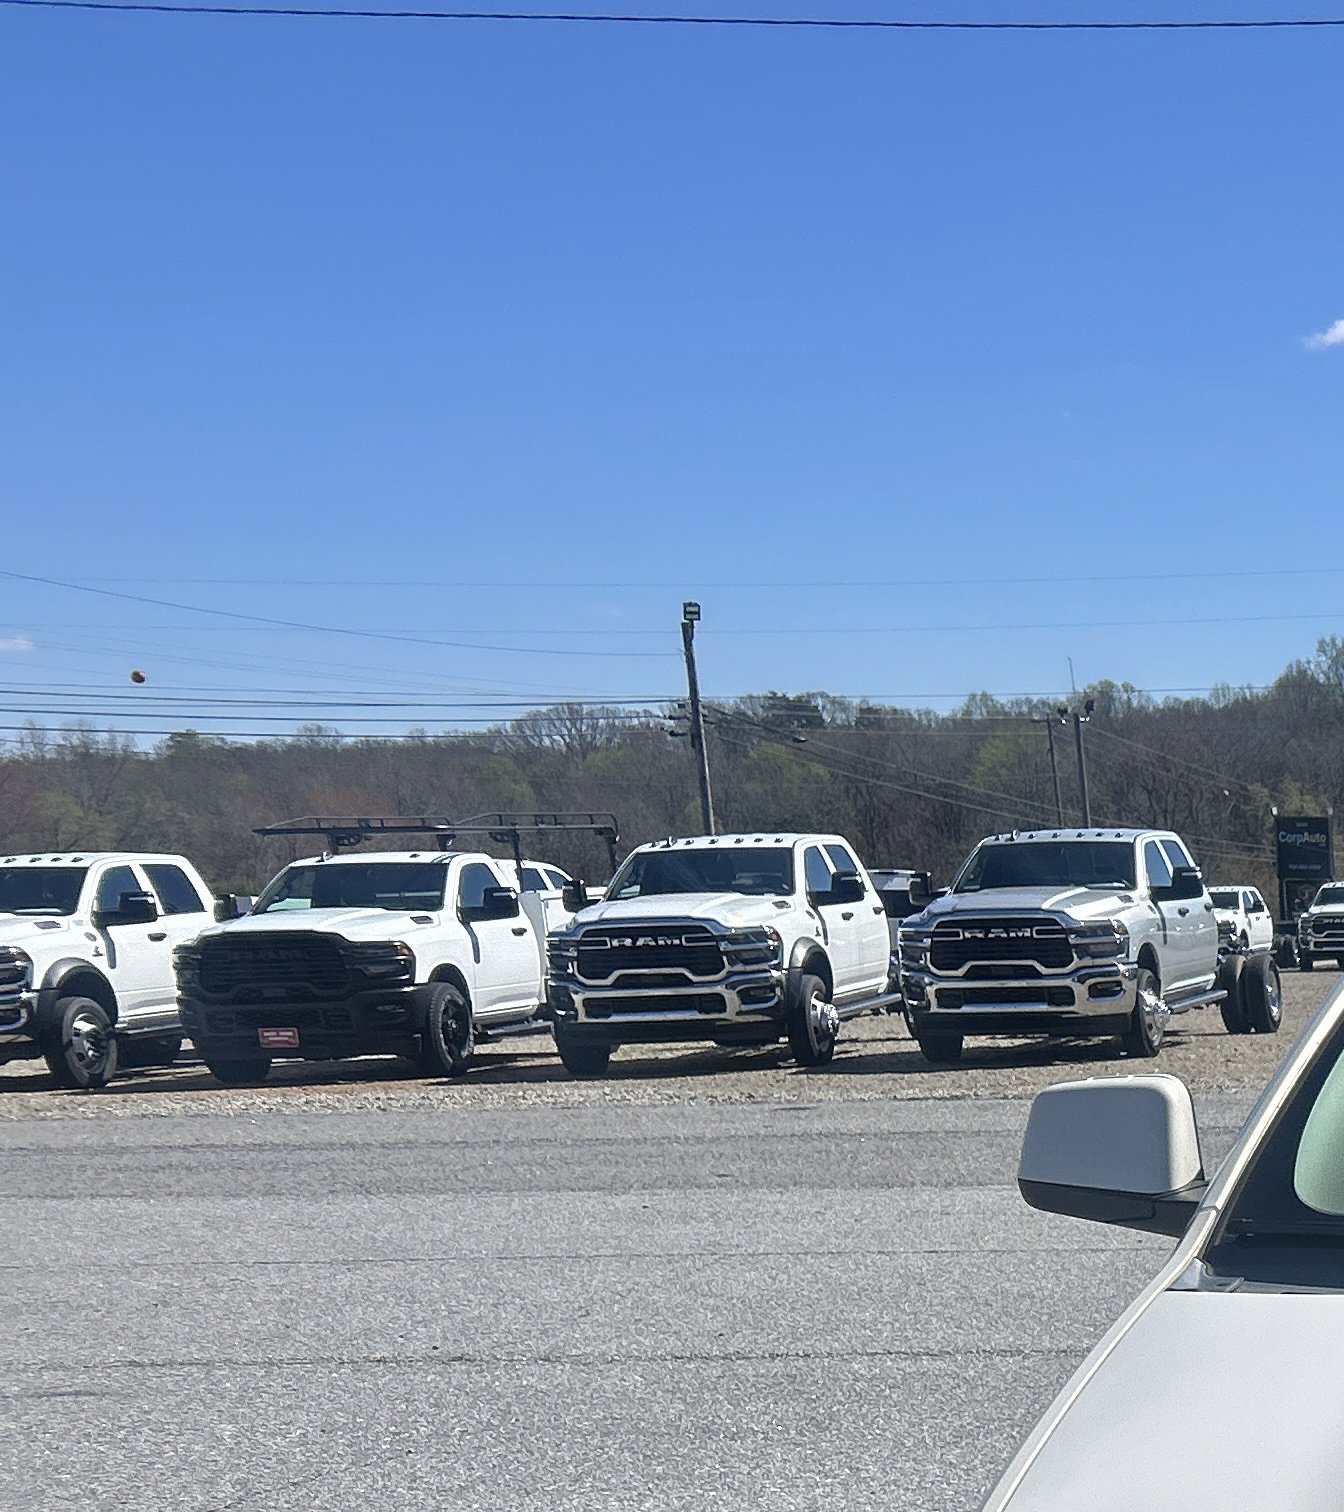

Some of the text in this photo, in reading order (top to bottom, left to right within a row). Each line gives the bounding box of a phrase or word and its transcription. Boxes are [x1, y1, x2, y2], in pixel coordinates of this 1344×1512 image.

[1278, 831, 1327, 845] CorpAuto
[963, 928, 1031, 938] RAM
[611, 936, 680, 947] RAM
